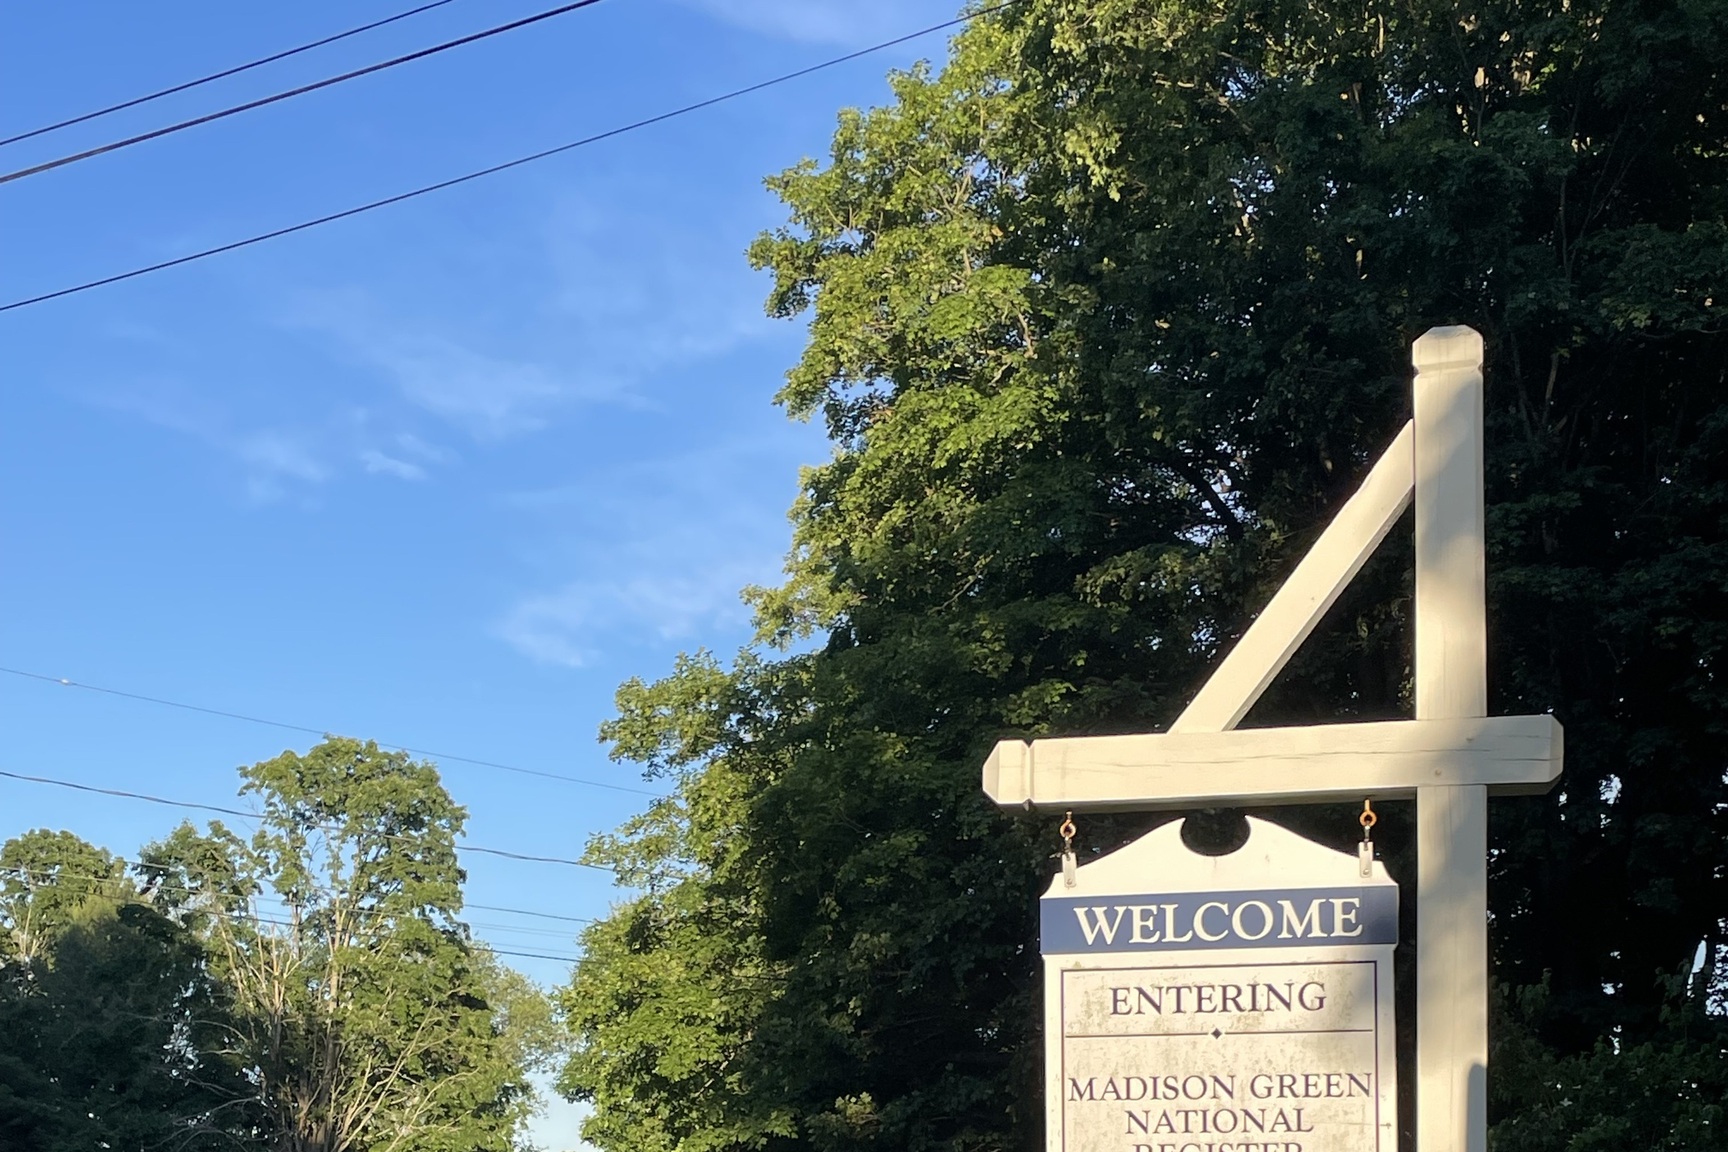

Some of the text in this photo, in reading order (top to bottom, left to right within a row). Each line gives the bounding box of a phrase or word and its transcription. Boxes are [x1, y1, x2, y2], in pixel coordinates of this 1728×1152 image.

[1073, 897, 1364, 946] WELCOME
[1109, 981, 1327, 1016] ENTERING
[1067, 1072, 1373, 1101] MADISON GREEN
[1124, 1107, 1315, 1135] NATIONAL
